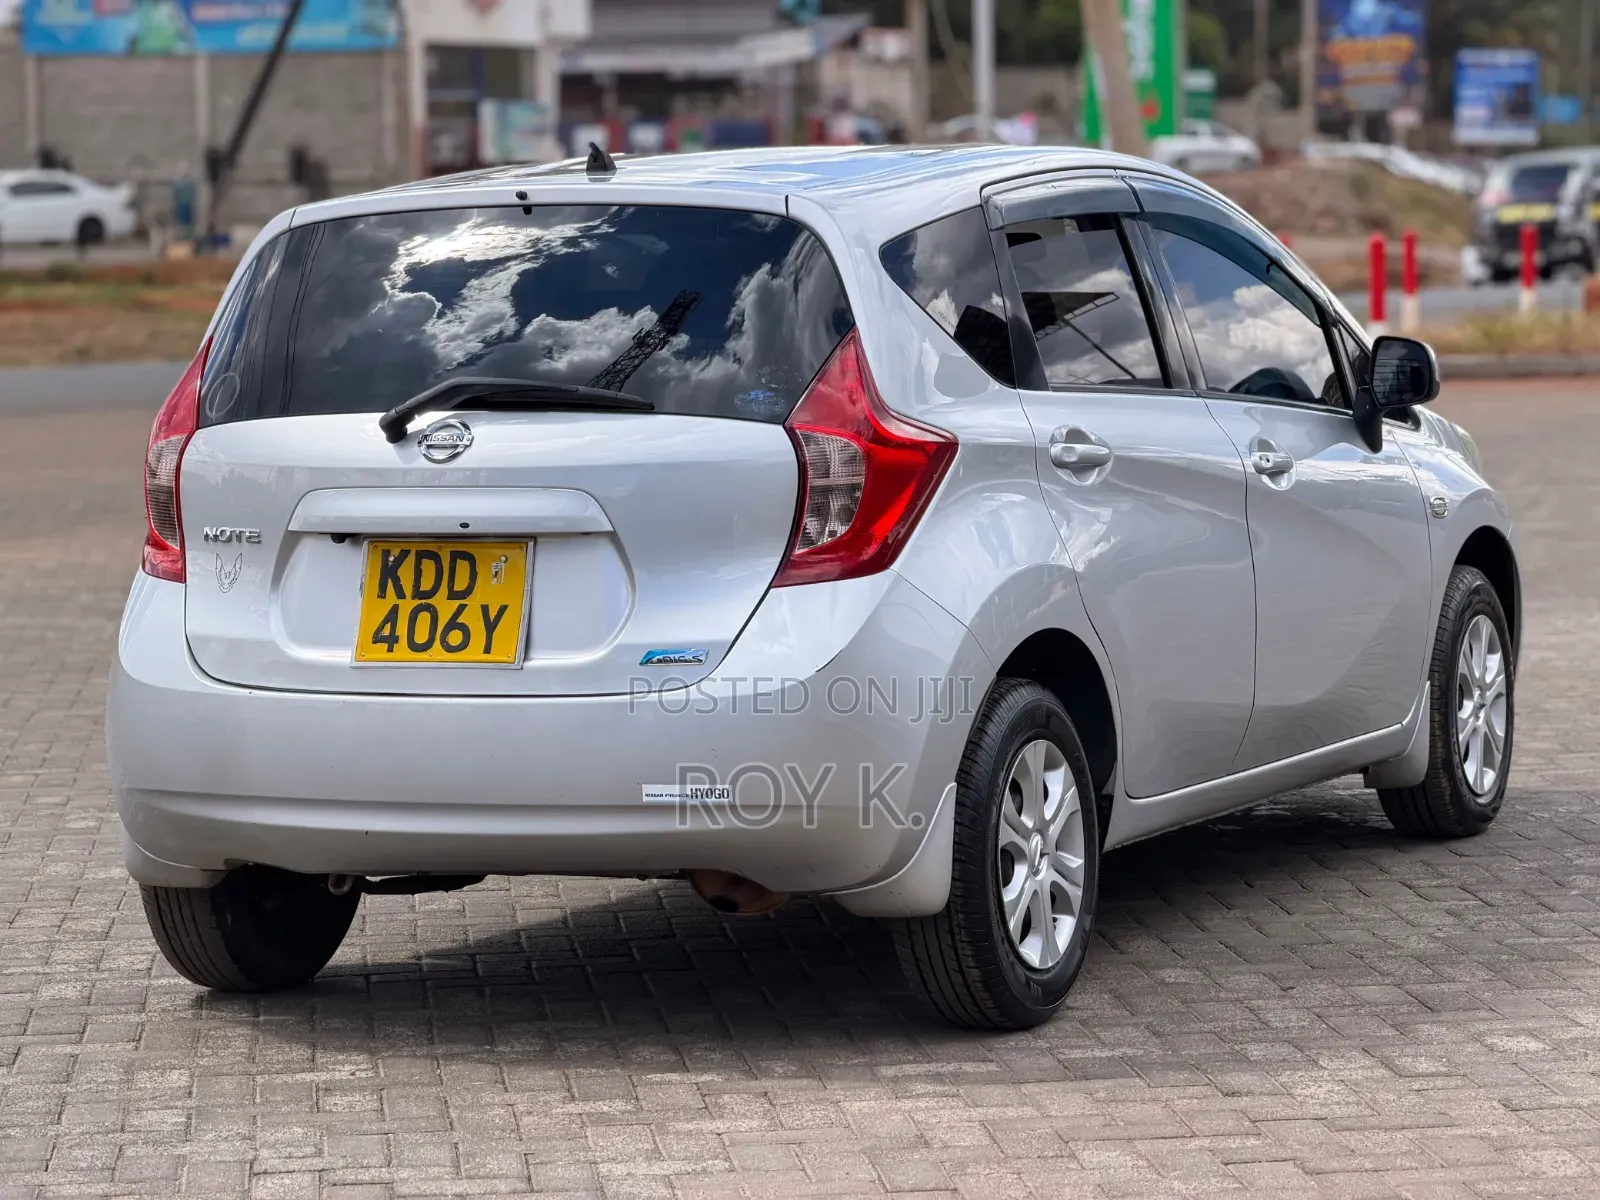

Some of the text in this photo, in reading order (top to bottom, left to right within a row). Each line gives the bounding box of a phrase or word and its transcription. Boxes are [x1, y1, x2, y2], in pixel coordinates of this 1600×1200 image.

[421, 434, 465, 443] NISSAN
[203, 526, 262, 545] NOTE
[377, 549, 479, 601] KDD
[372, 602, 510, 655] 406Y
[690, 787, 730, 800] HYOGO
